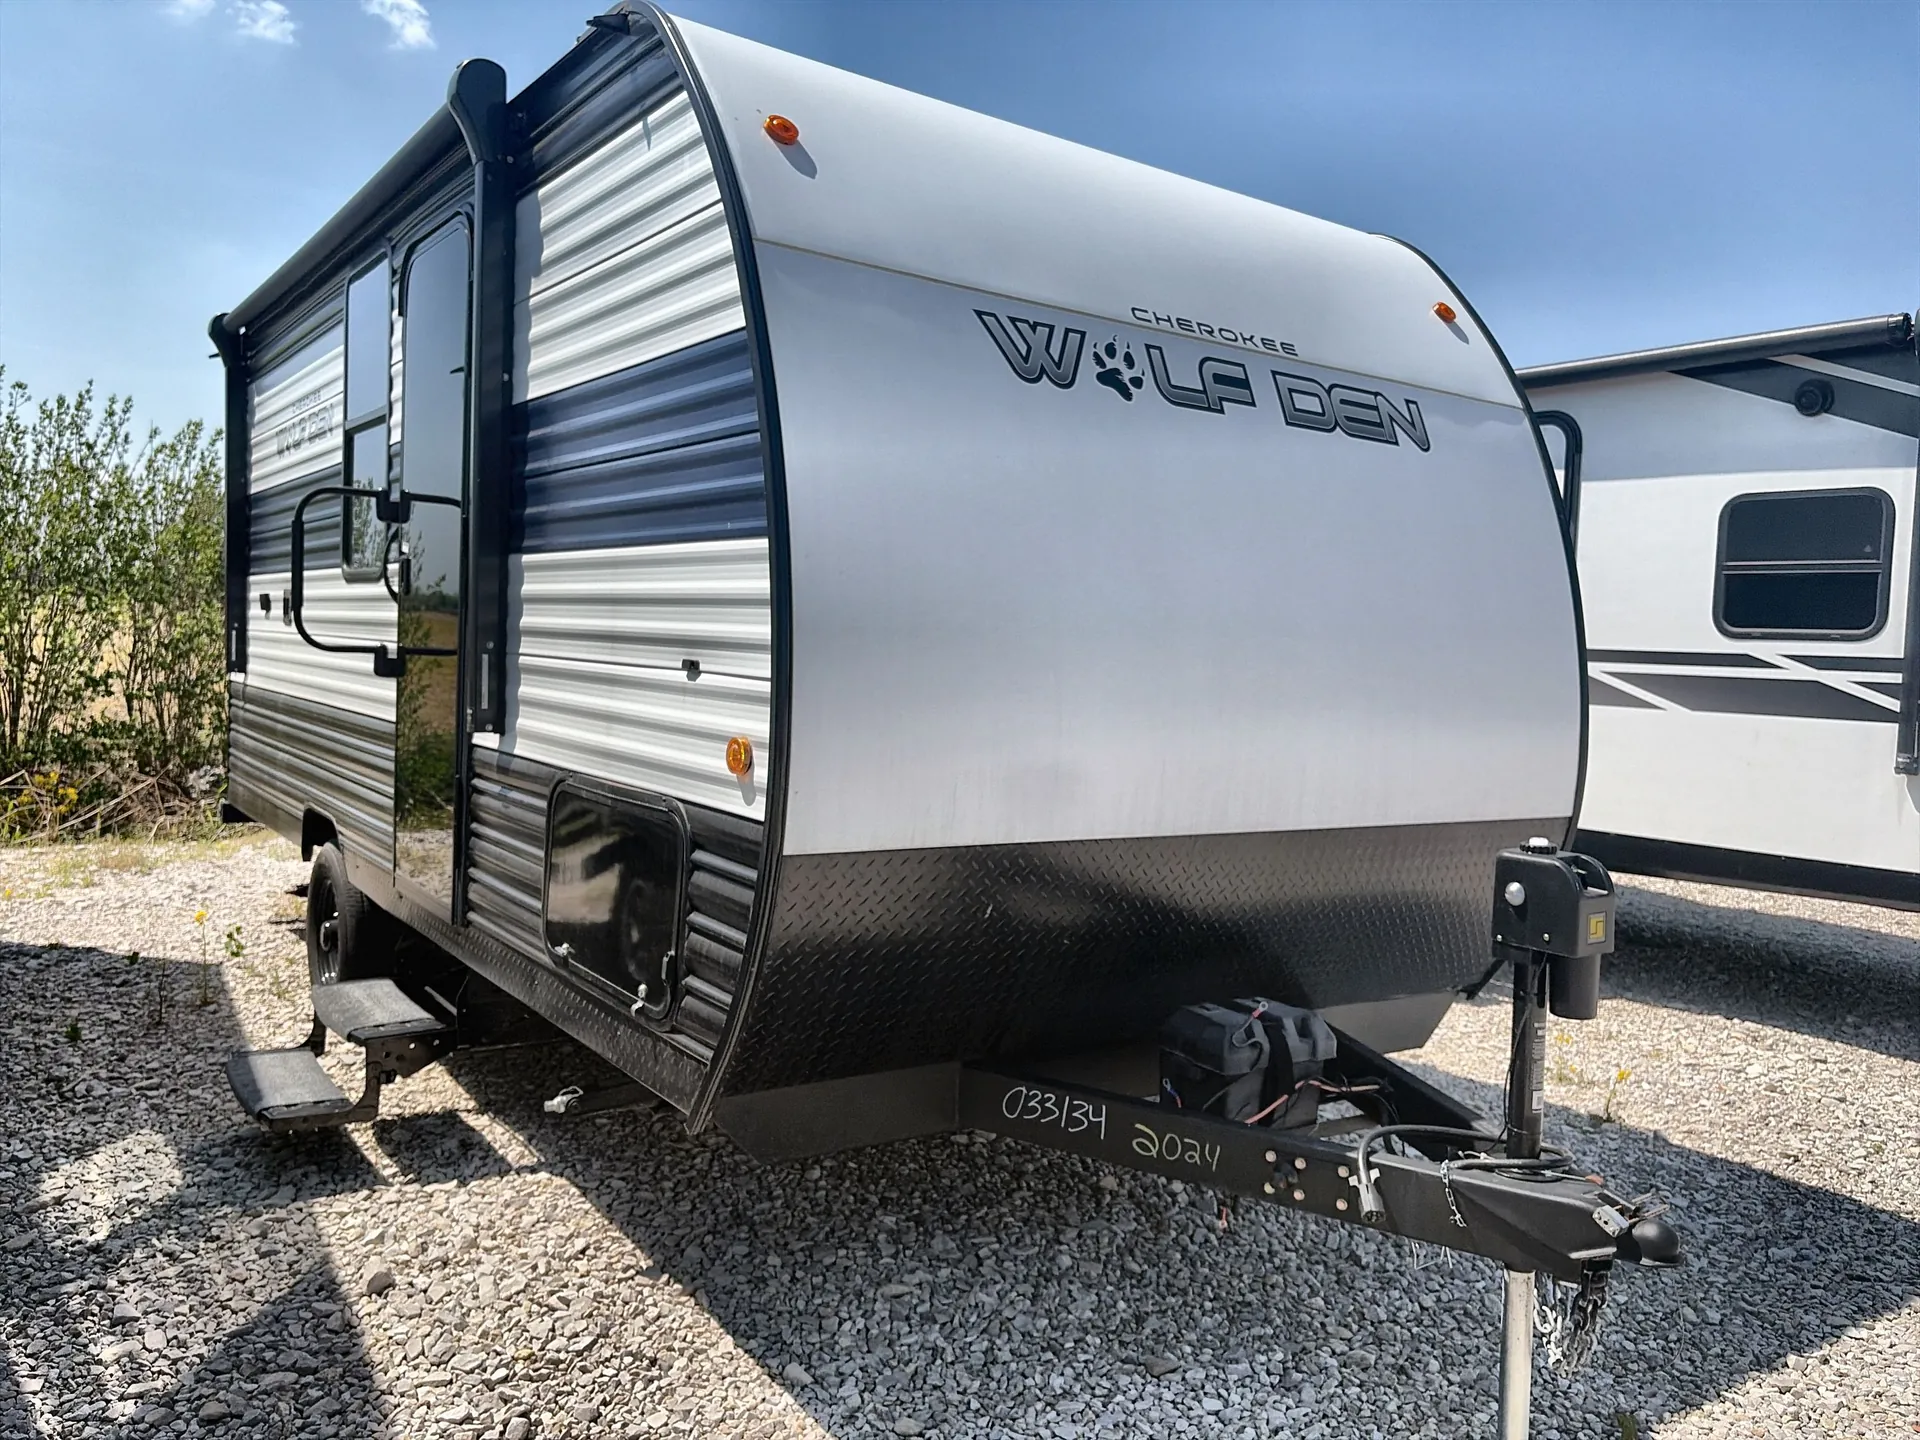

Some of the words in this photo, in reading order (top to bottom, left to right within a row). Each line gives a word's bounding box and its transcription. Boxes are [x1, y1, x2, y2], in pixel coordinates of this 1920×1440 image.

[1130, 307, 1298, 357] CHEROKEE
[1270, 370, 1430, 453] DEN
[1002, 1086, 1107, 1140] 033134
[1132, 1123, 1221, 1172] 2024
